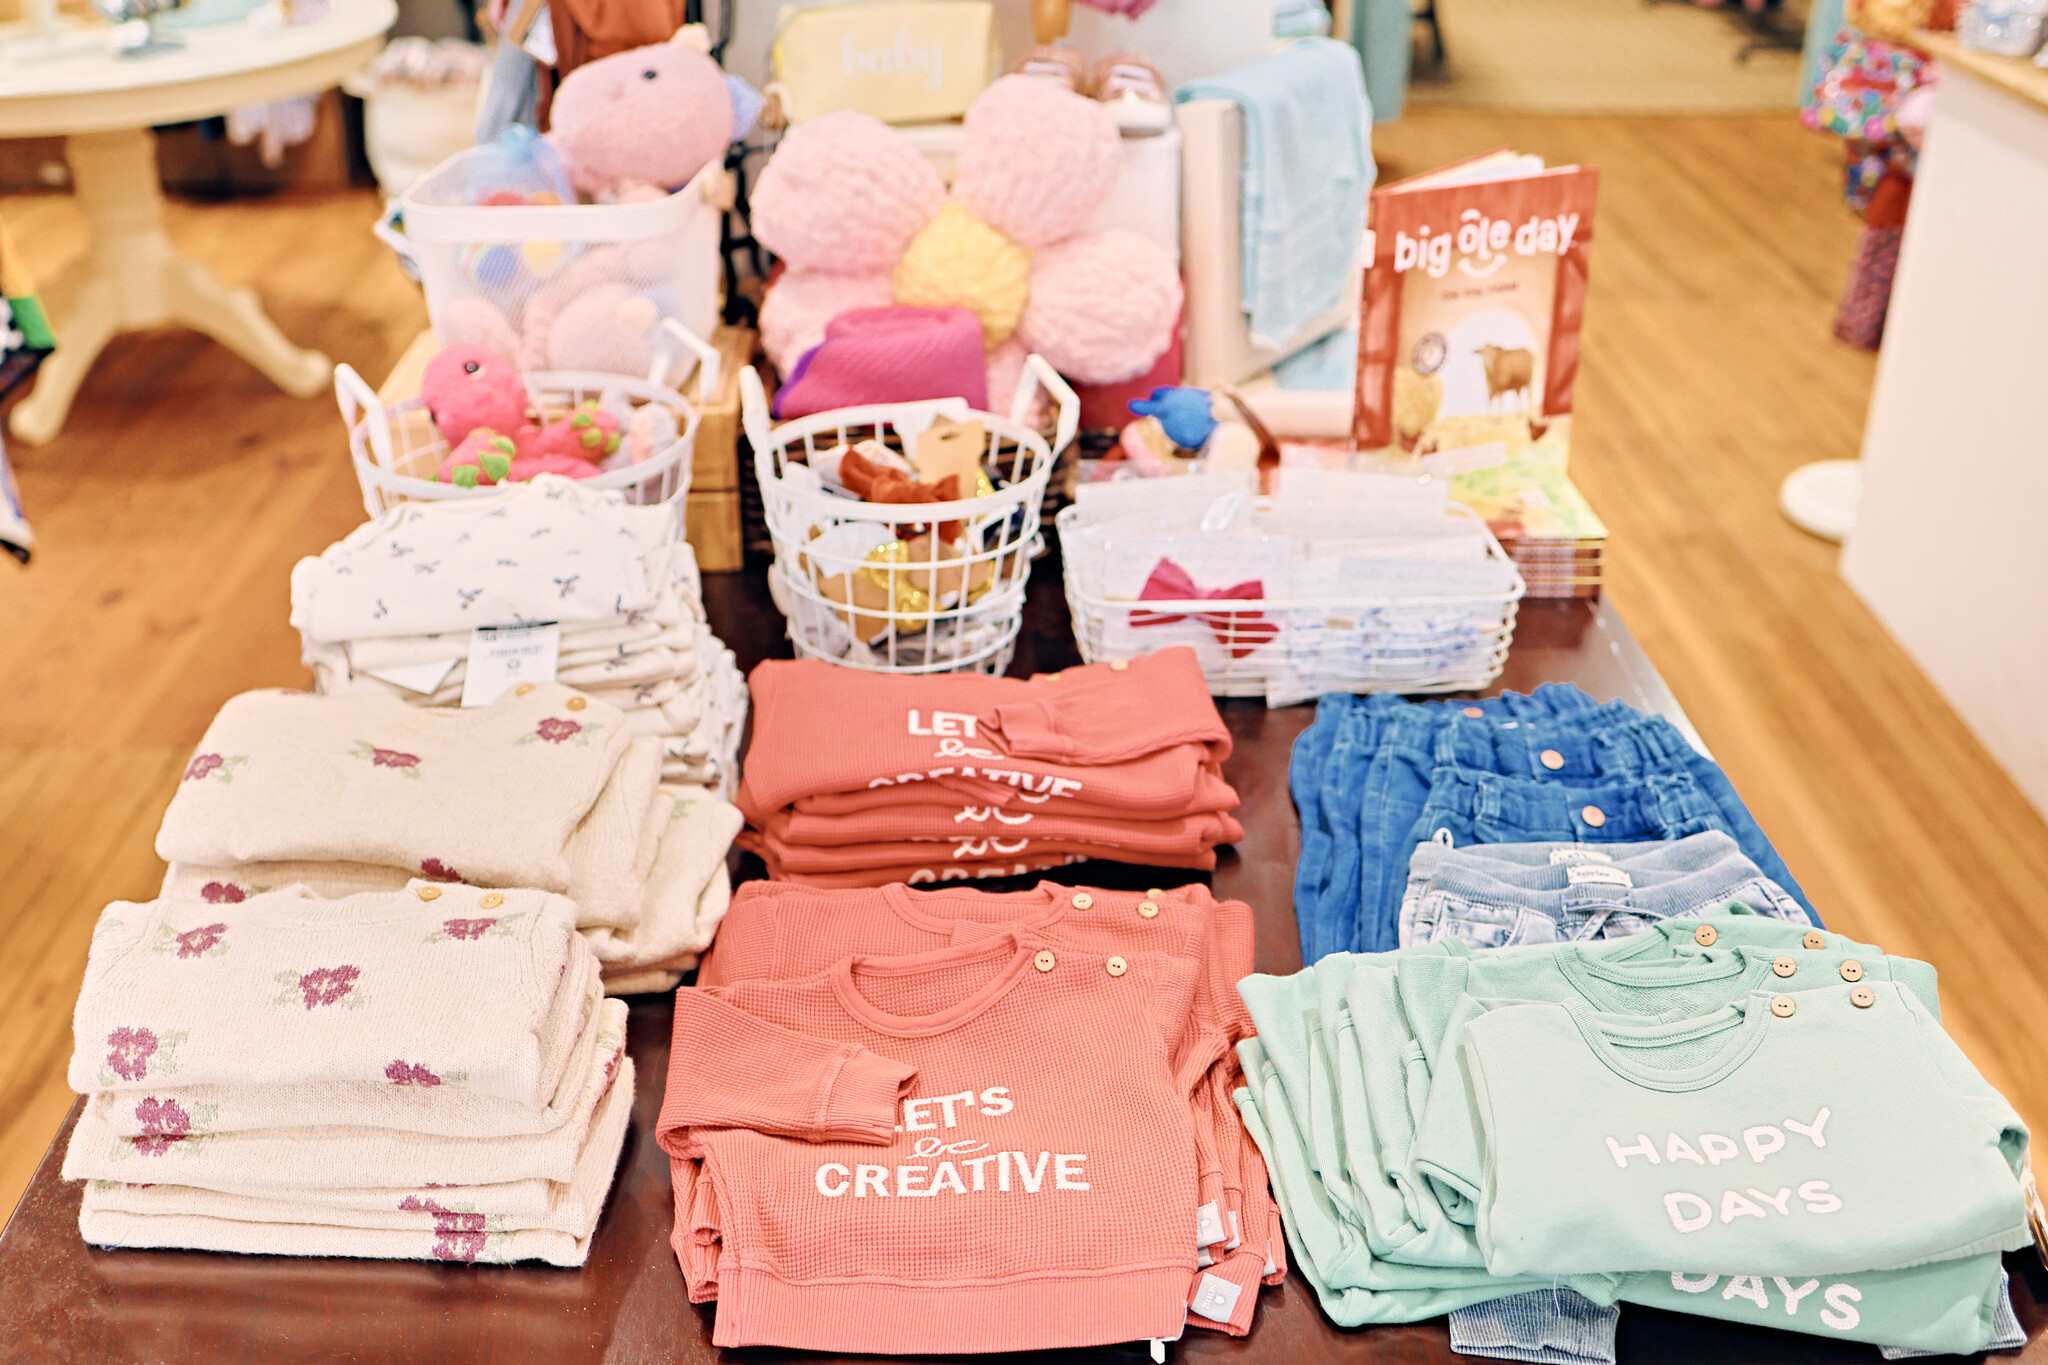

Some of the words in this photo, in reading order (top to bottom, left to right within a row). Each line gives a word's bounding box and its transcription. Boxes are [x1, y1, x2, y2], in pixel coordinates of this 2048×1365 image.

[841, 27, 944, 90] baby
[1394, 225, 1452, 278] big
[1515, 213, 1579, 256] day
[908, 709, 978, 738] LET
[894, 1086, 1014, 1132] ET'S
[1604, 1106, 1831, 1168] HAPPY
[814, 1151, 1090, 1198] CREATIVE
[1663, 1180, 1842, 1234] DAYS
